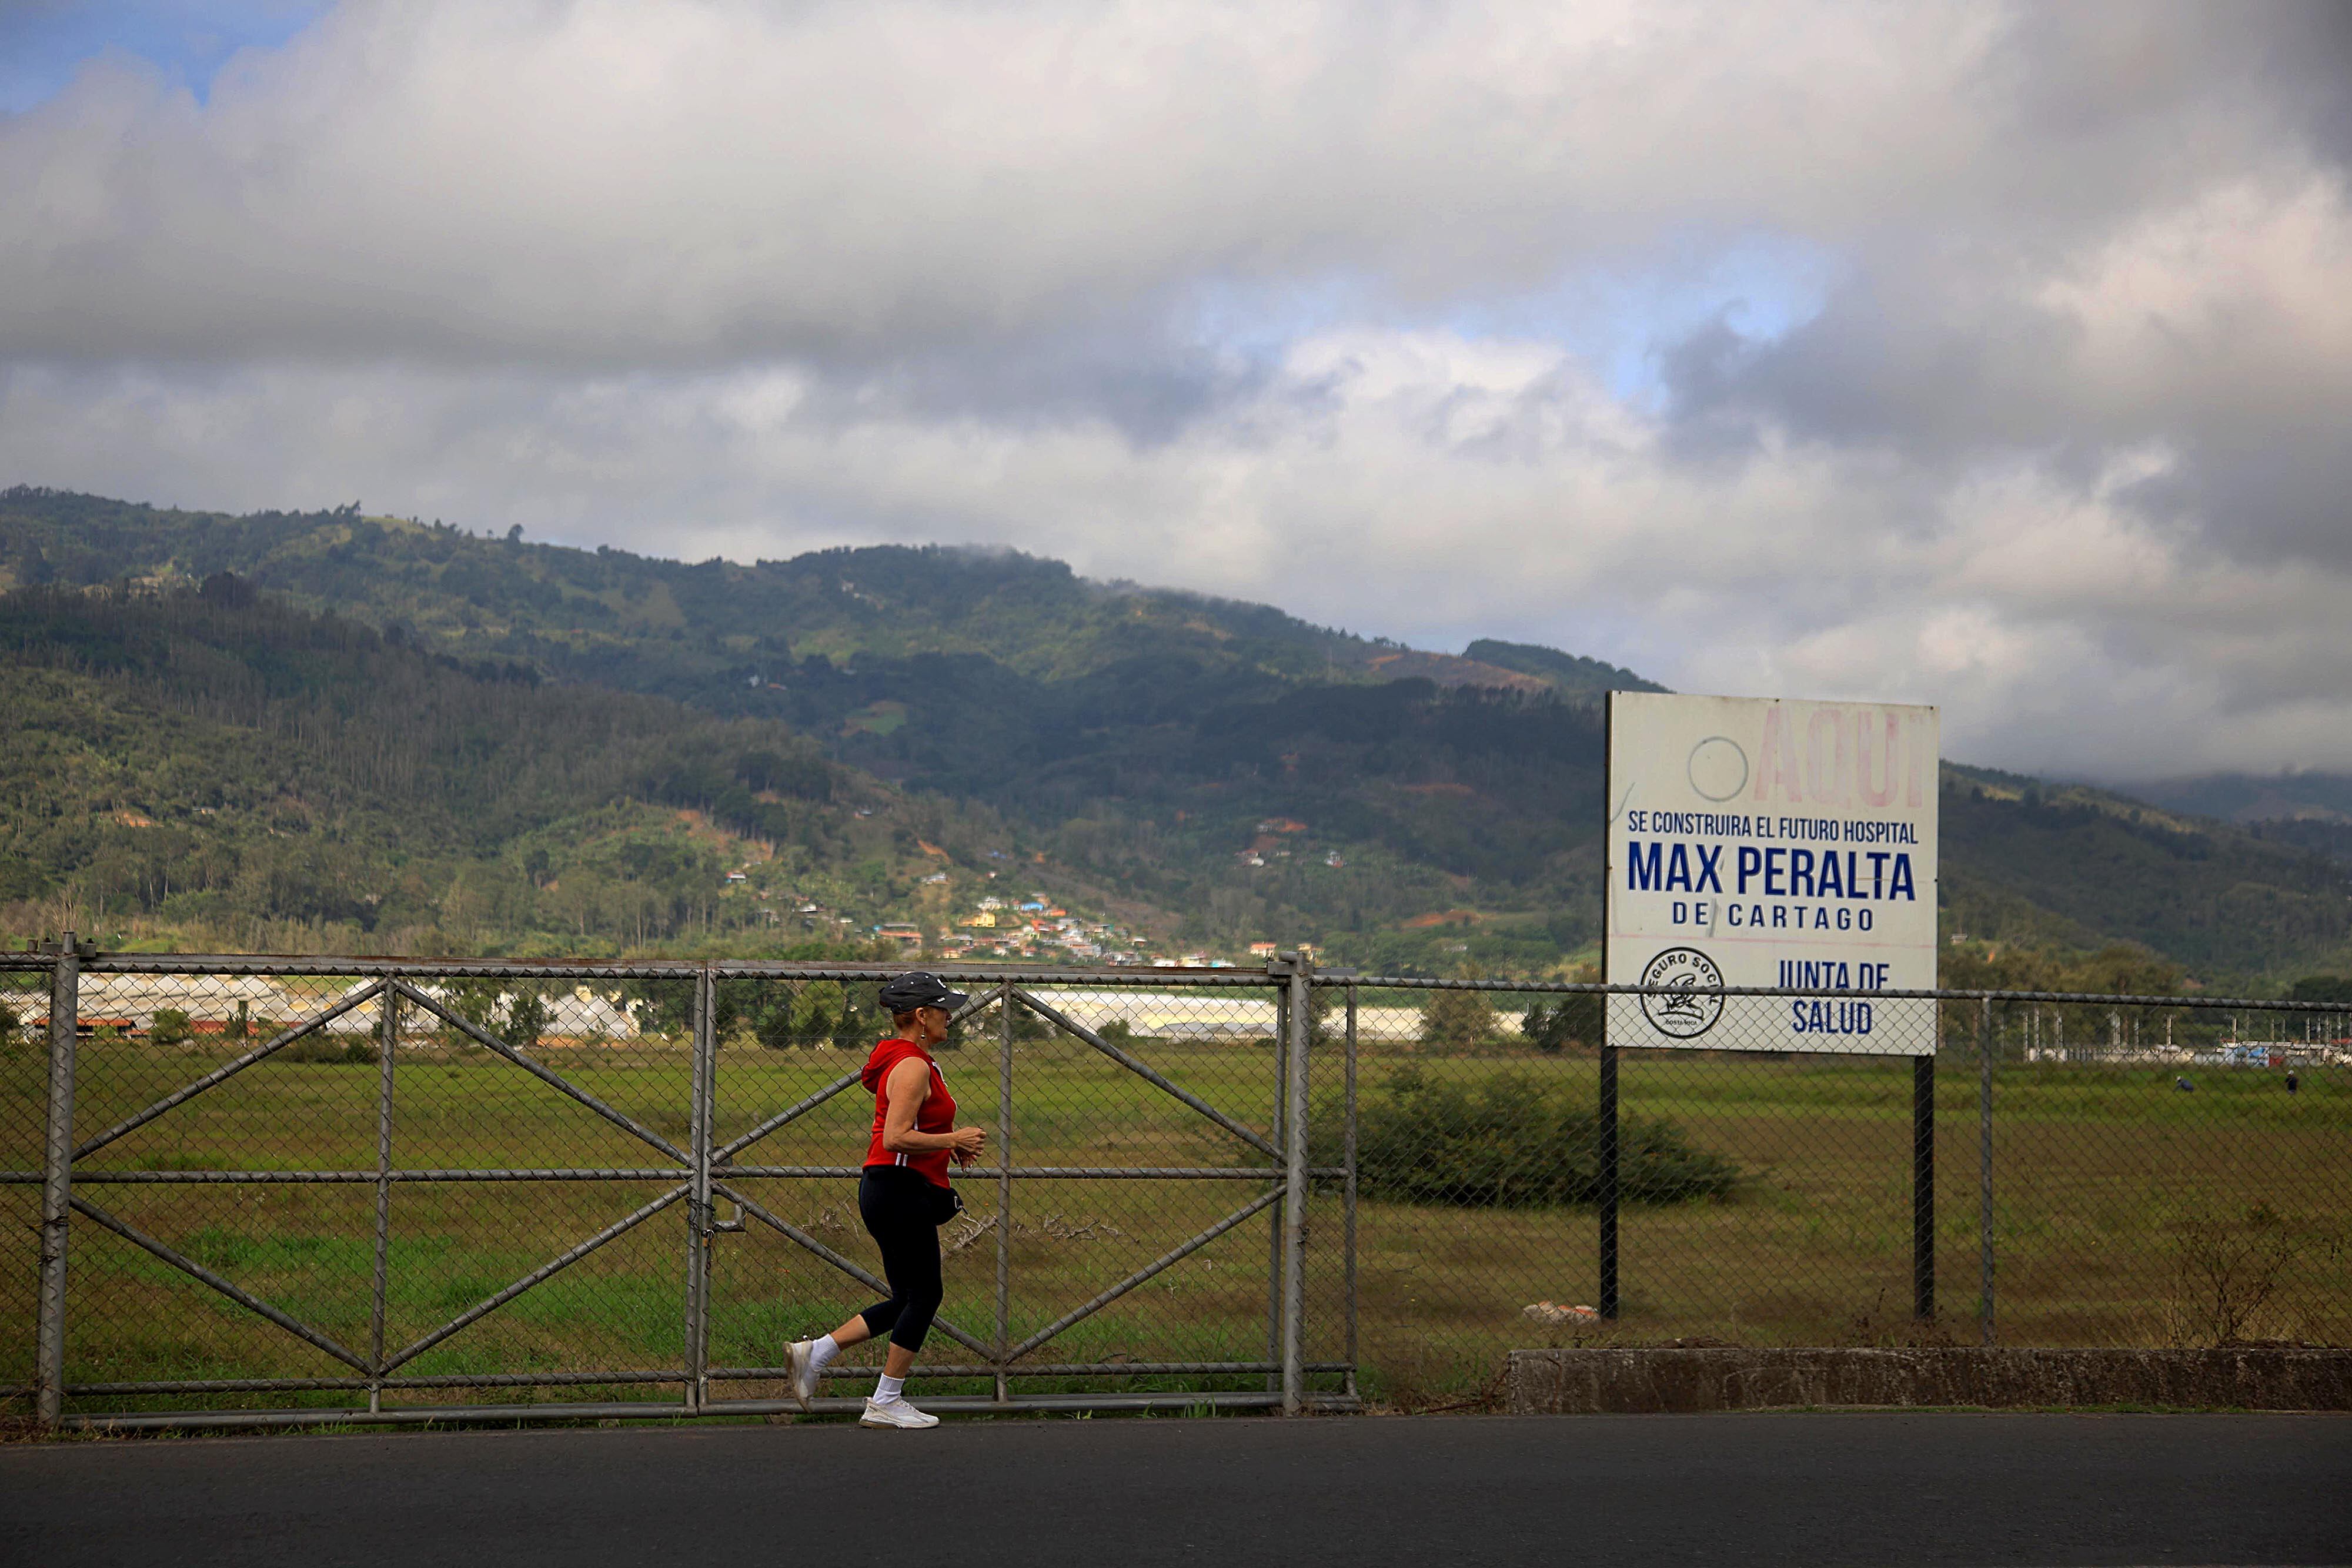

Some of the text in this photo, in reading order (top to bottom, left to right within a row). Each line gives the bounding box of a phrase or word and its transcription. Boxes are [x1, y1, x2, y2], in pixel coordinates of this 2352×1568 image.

[1628, 810, 1919, 844] SE CONSTRUIRA EL FUTURO HOSPITAL
[1628, 841, 1916, 901] MAX PERALTA
[1673, 902, 1873, 931] DE CARTAGO
[1780, 960, 1850, 989] JUNTA
[1793, 999, 1872, 1035] SALUD
